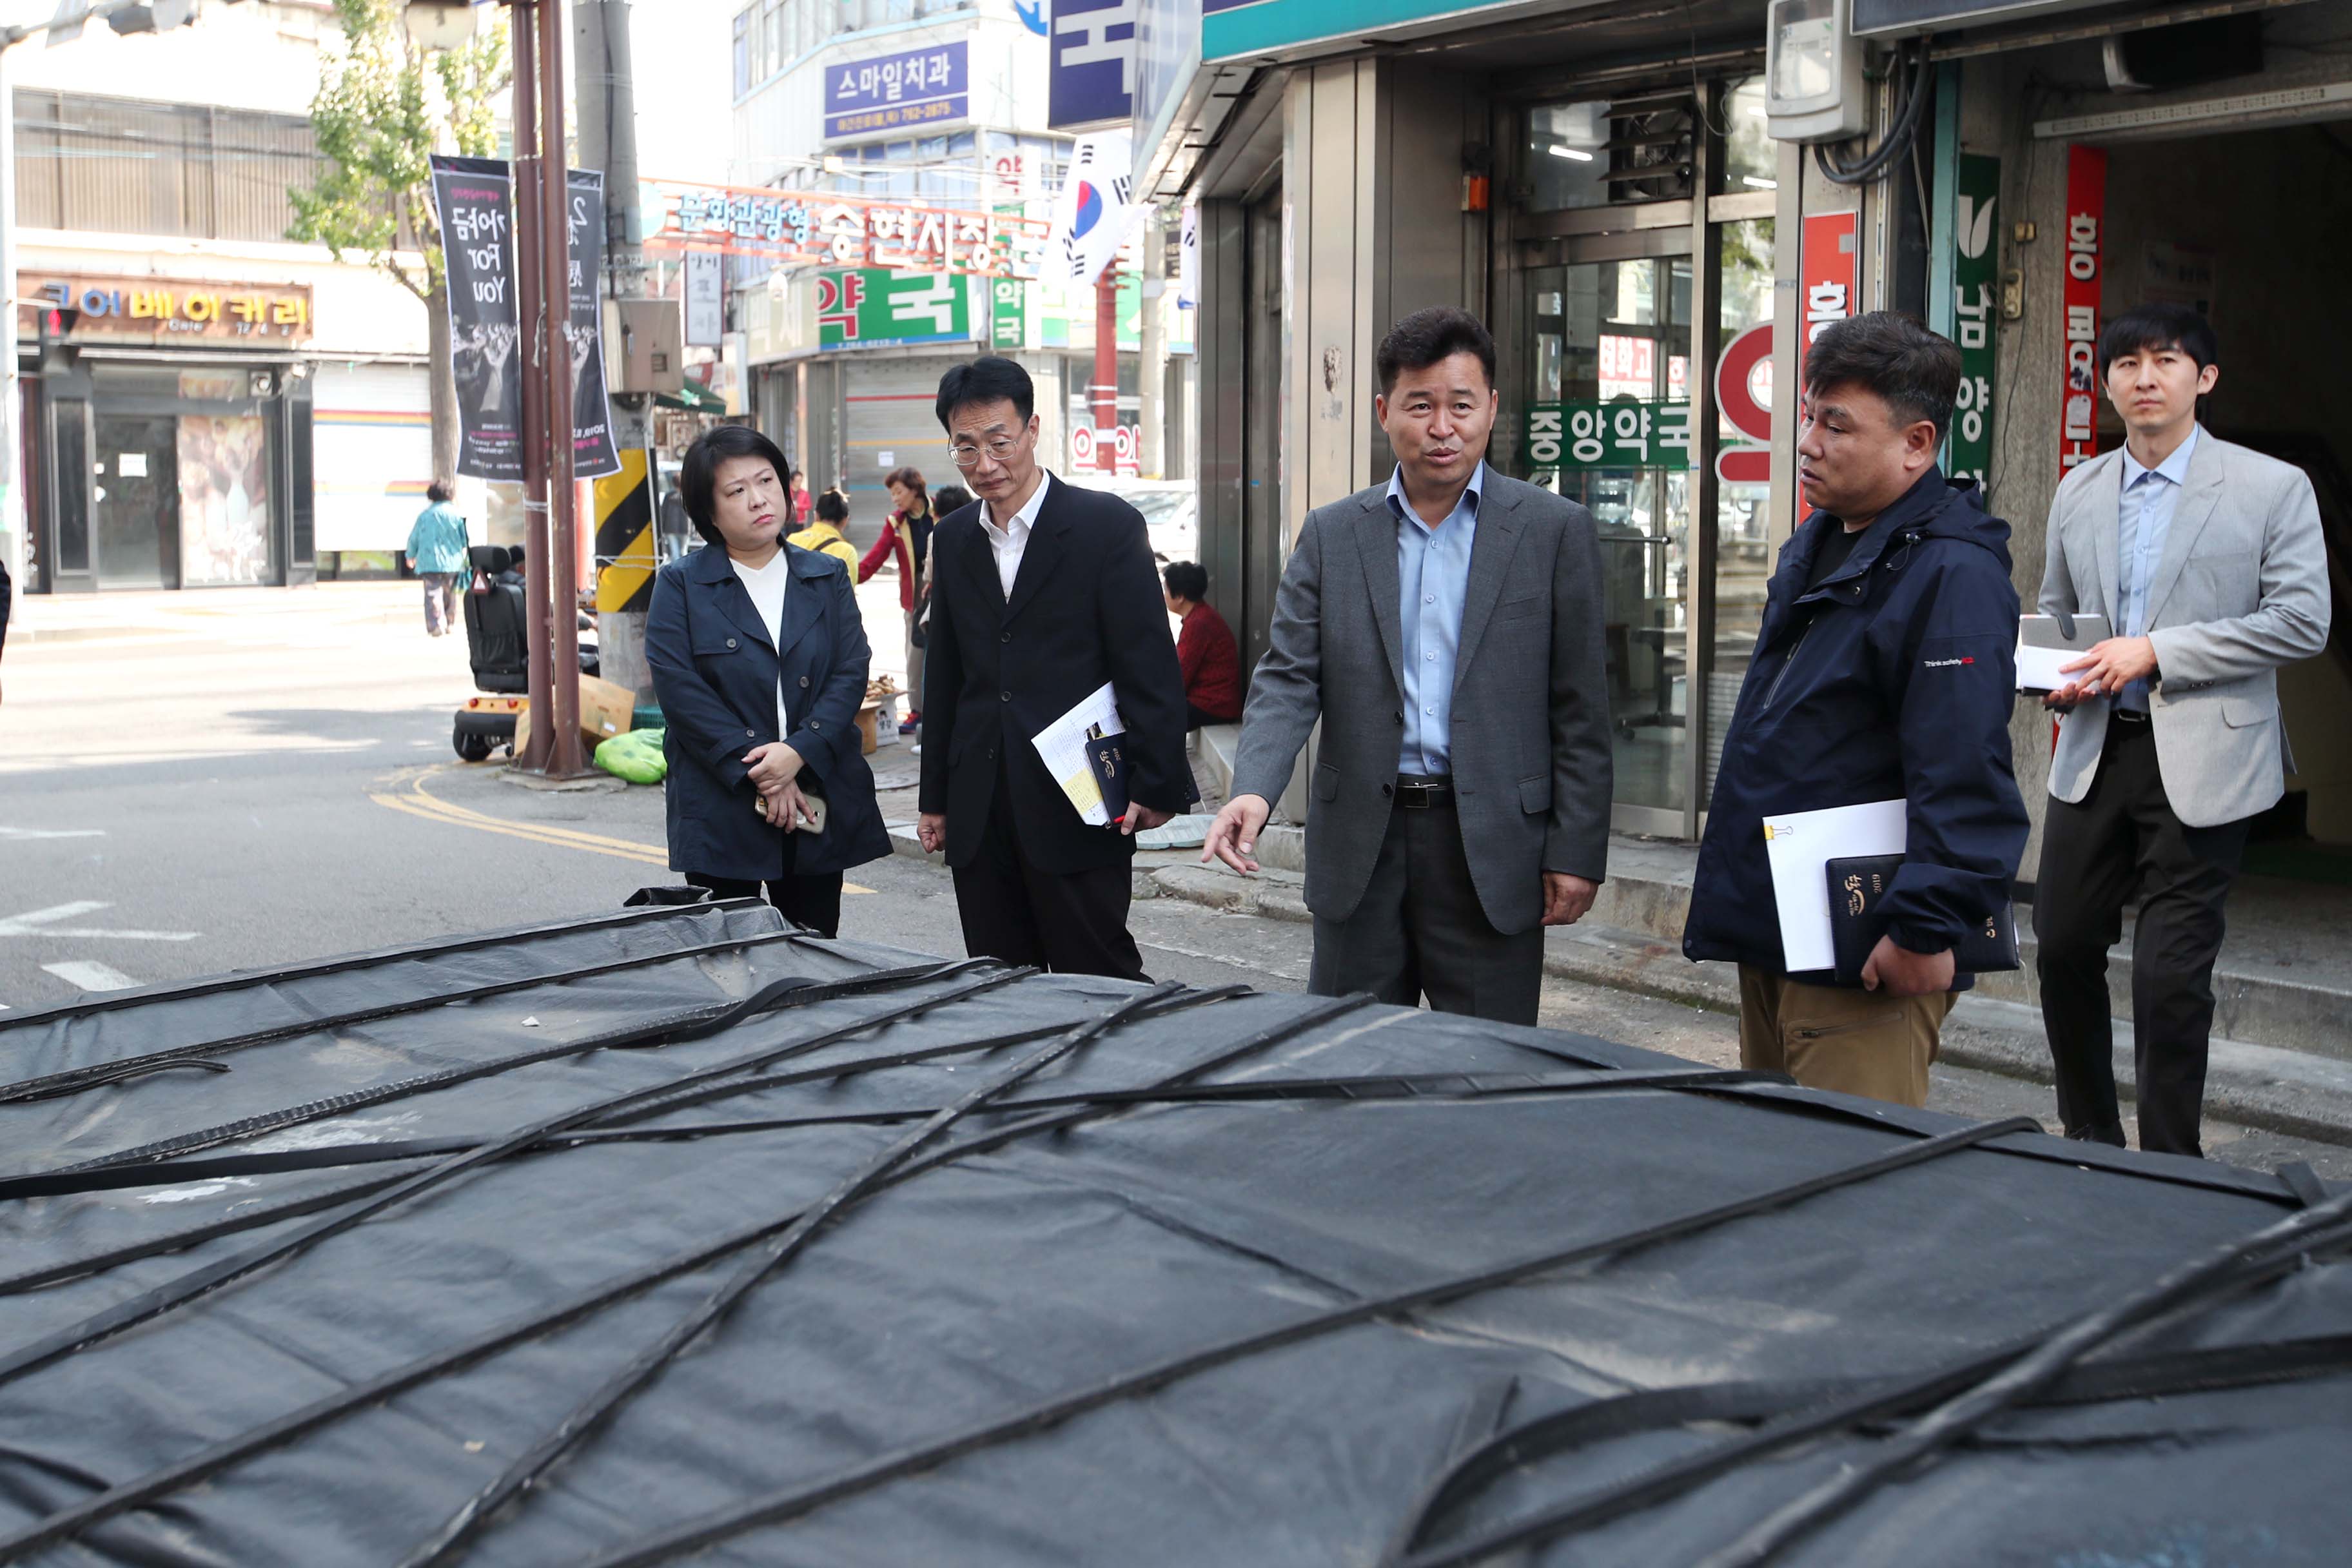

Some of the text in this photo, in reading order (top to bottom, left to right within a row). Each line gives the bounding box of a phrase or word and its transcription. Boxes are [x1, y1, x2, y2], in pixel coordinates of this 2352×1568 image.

[837, 52, 951, 101] 스마일치과
[678, 193, 810, 244] 문화관광형
[819, 203, 1000, 271] 송현시장
[1529, 406, 1692, 463] 중앙약국
[1872, 874, 1882, 894] 2019
